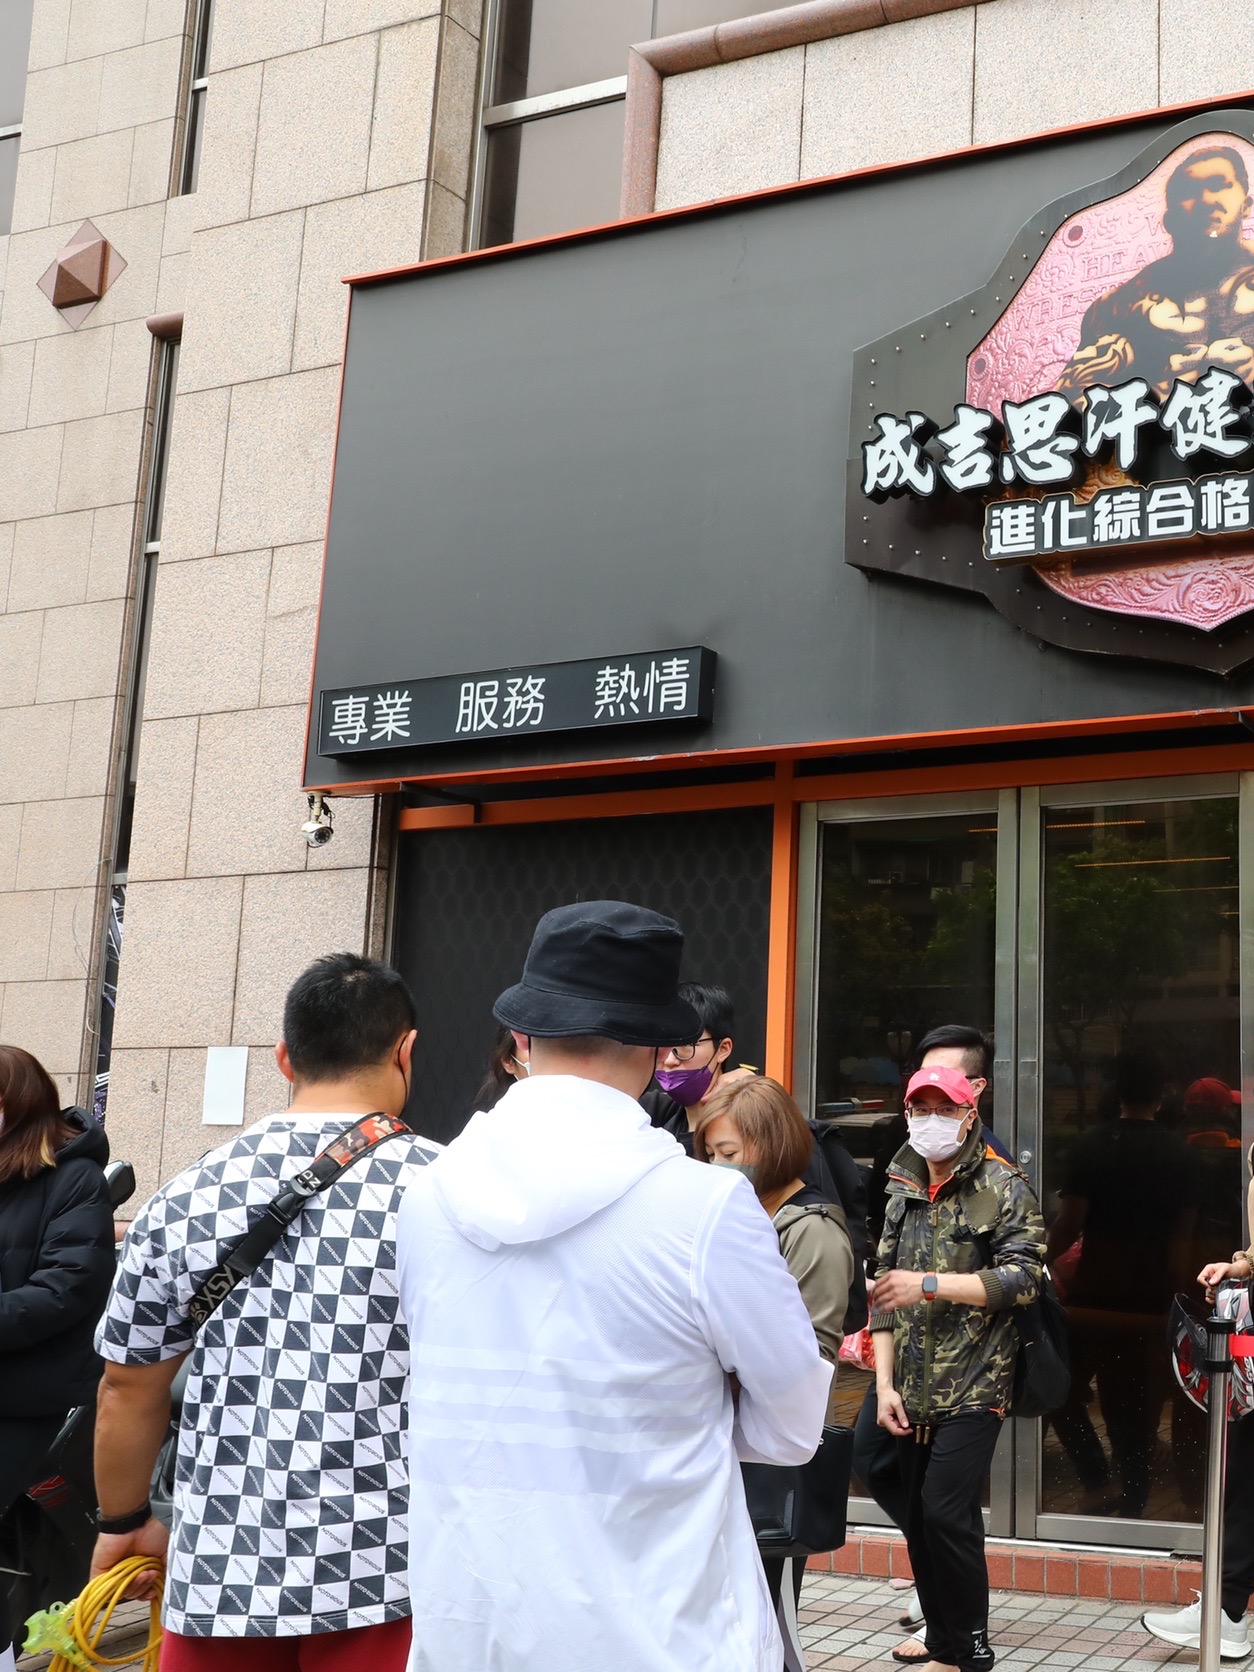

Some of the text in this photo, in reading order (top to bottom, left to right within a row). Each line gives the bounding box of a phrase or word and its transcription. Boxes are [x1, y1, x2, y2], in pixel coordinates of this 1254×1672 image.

[328, 657, 690, 745] 專業 服務 熱情
